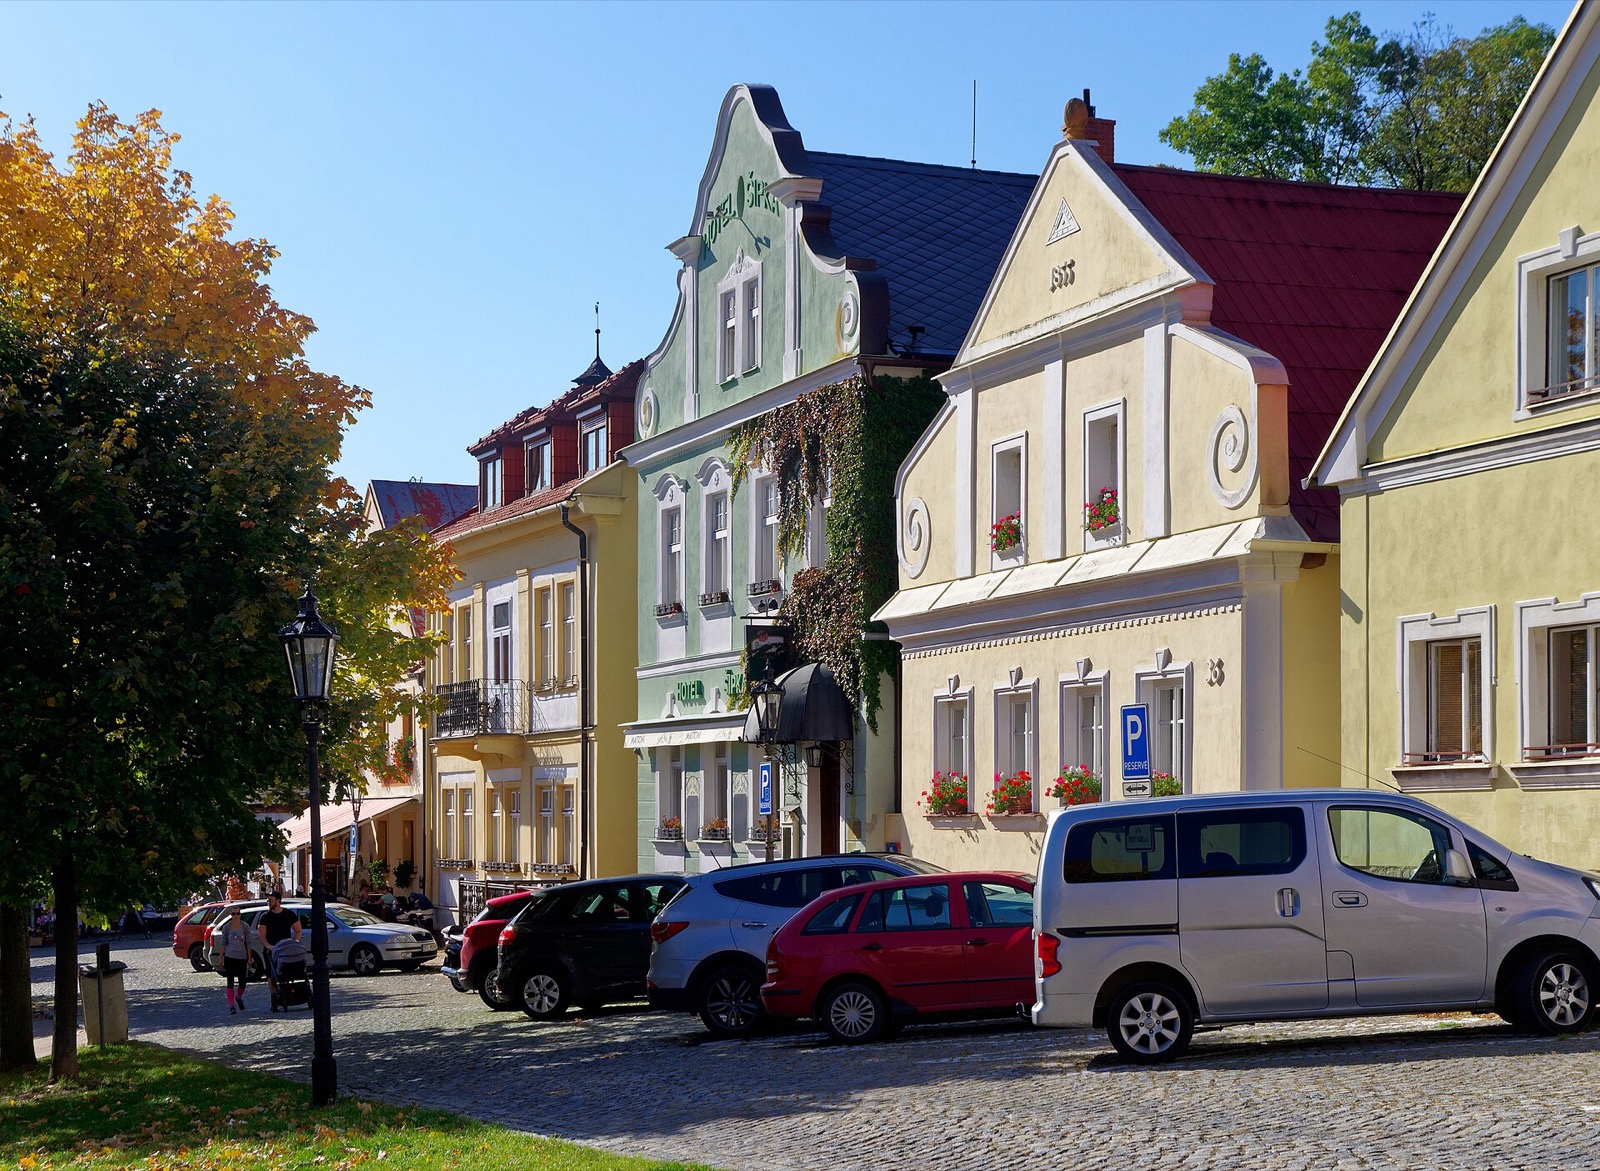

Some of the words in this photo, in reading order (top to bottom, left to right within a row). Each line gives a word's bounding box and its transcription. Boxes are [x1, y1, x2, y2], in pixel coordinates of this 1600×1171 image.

[677, 680, 702, 701] HOTEL
[1126, 714, 1143, 756] P
[761, 769, 769, 799] P
